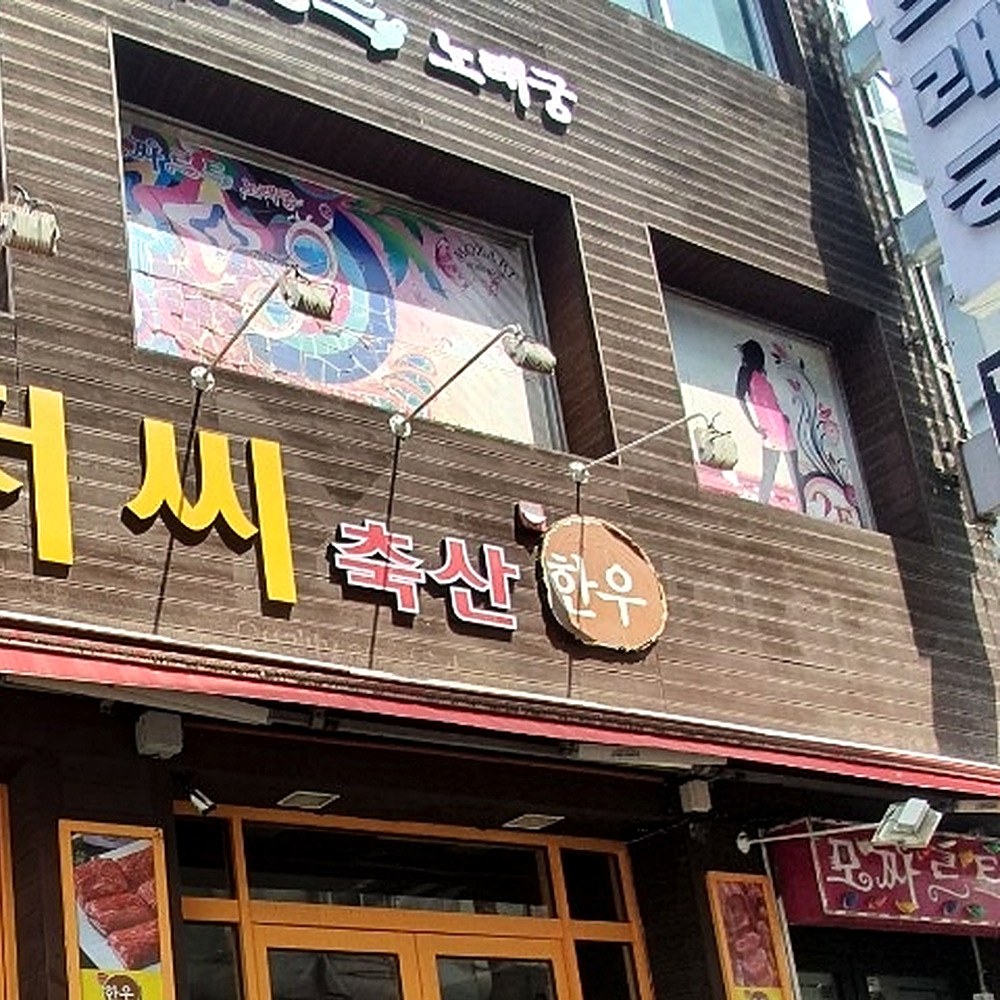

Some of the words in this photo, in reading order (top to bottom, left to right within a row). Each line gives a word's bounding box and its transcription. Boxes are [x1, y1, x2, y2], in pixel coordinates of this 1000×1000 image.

[427, 27, 579, 125] 노래궁
[334, 519, 521, 630] 축산
[547, 552, 648, 628] 한우
